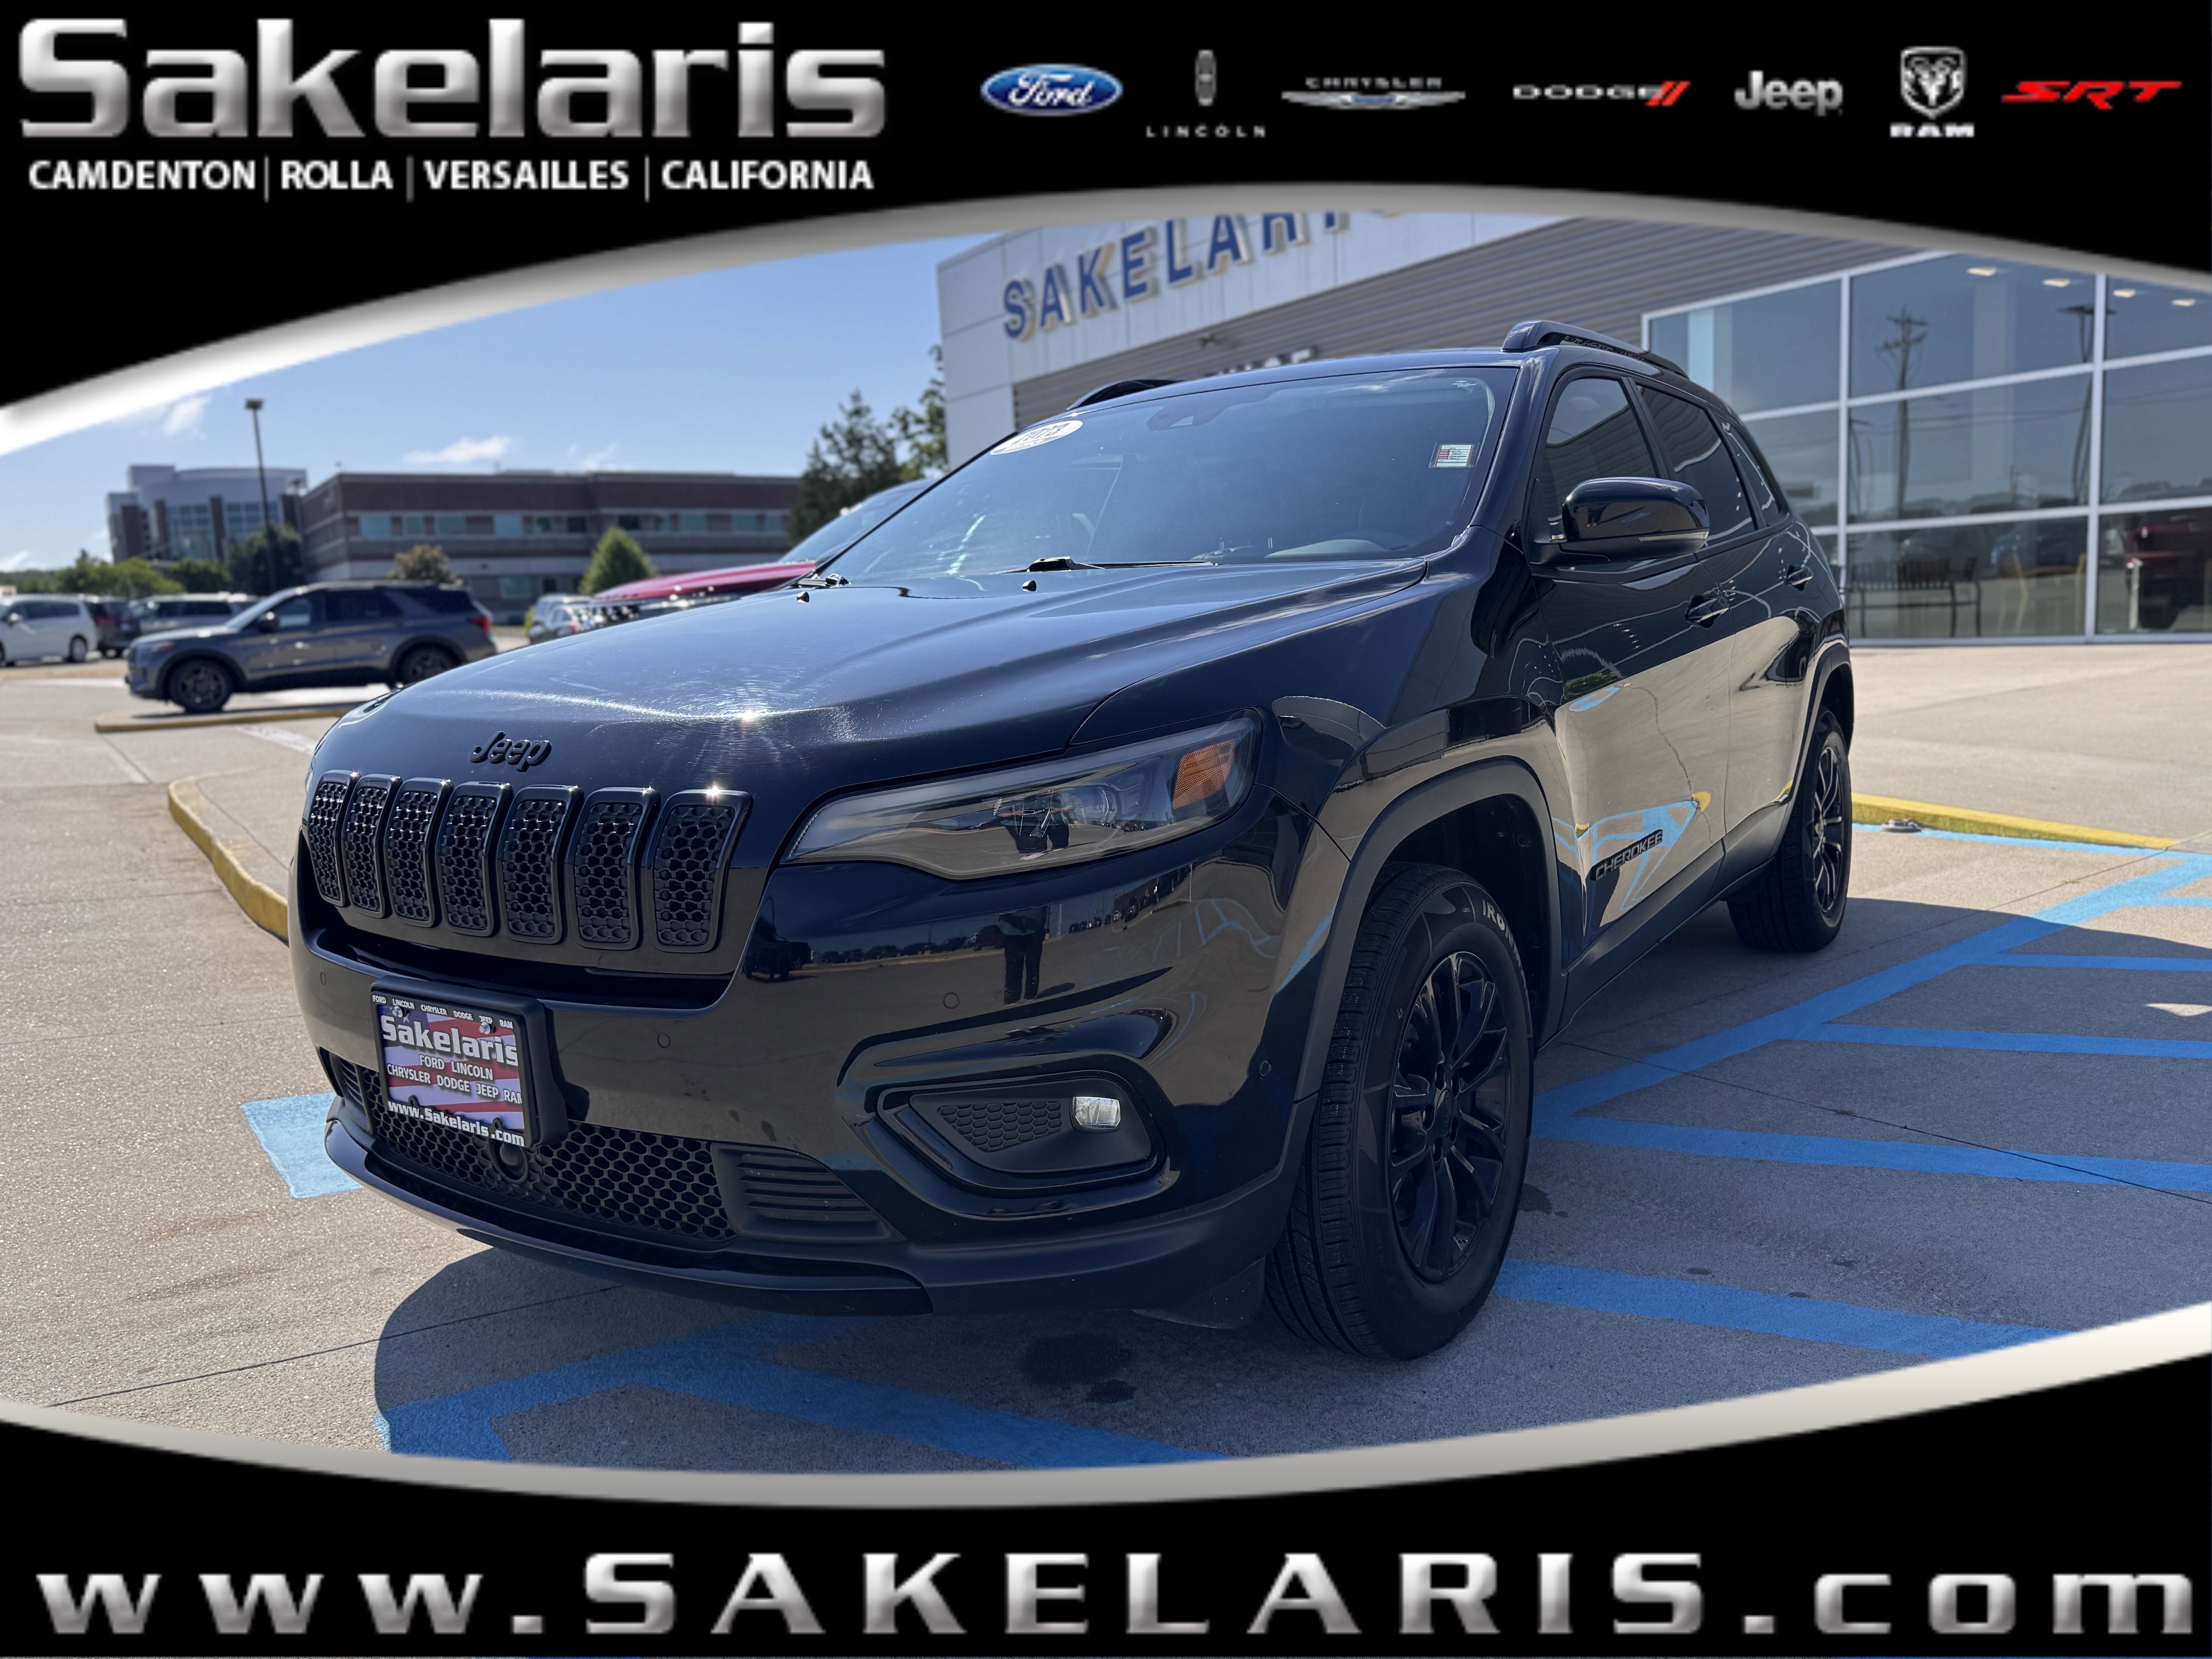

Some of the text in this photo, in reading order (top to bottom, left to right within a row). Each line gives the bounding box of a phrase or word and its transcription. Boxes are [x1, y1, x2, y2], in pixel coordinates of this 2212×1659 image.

[1003, 209, 1394, 343] SAKELAR
[468, 731, 553, 773] Jeep
[1590, 828, 1663, 881] CHEROKEE
[1482, 898, 1529, 999] IRONM
[372, 994, 387, 1004] FORD
[392, 998, 415, 1009] LINCOLN
[421, 1004, 448, 1016] CHRYSLER
[453, 1010, 474, 1021] DODGE
[499, 1019, 514, 1029] RAM
[380, 1015, 519, 1067] Sakelaris
[387, 1064, 431, 1084] CHRYSLER
[436, 1074, 471, 1092] DODGE
[476, 1082, 499, 1098] JEEP
[419, 1054, 494, 1080] FORD LINCOLN
